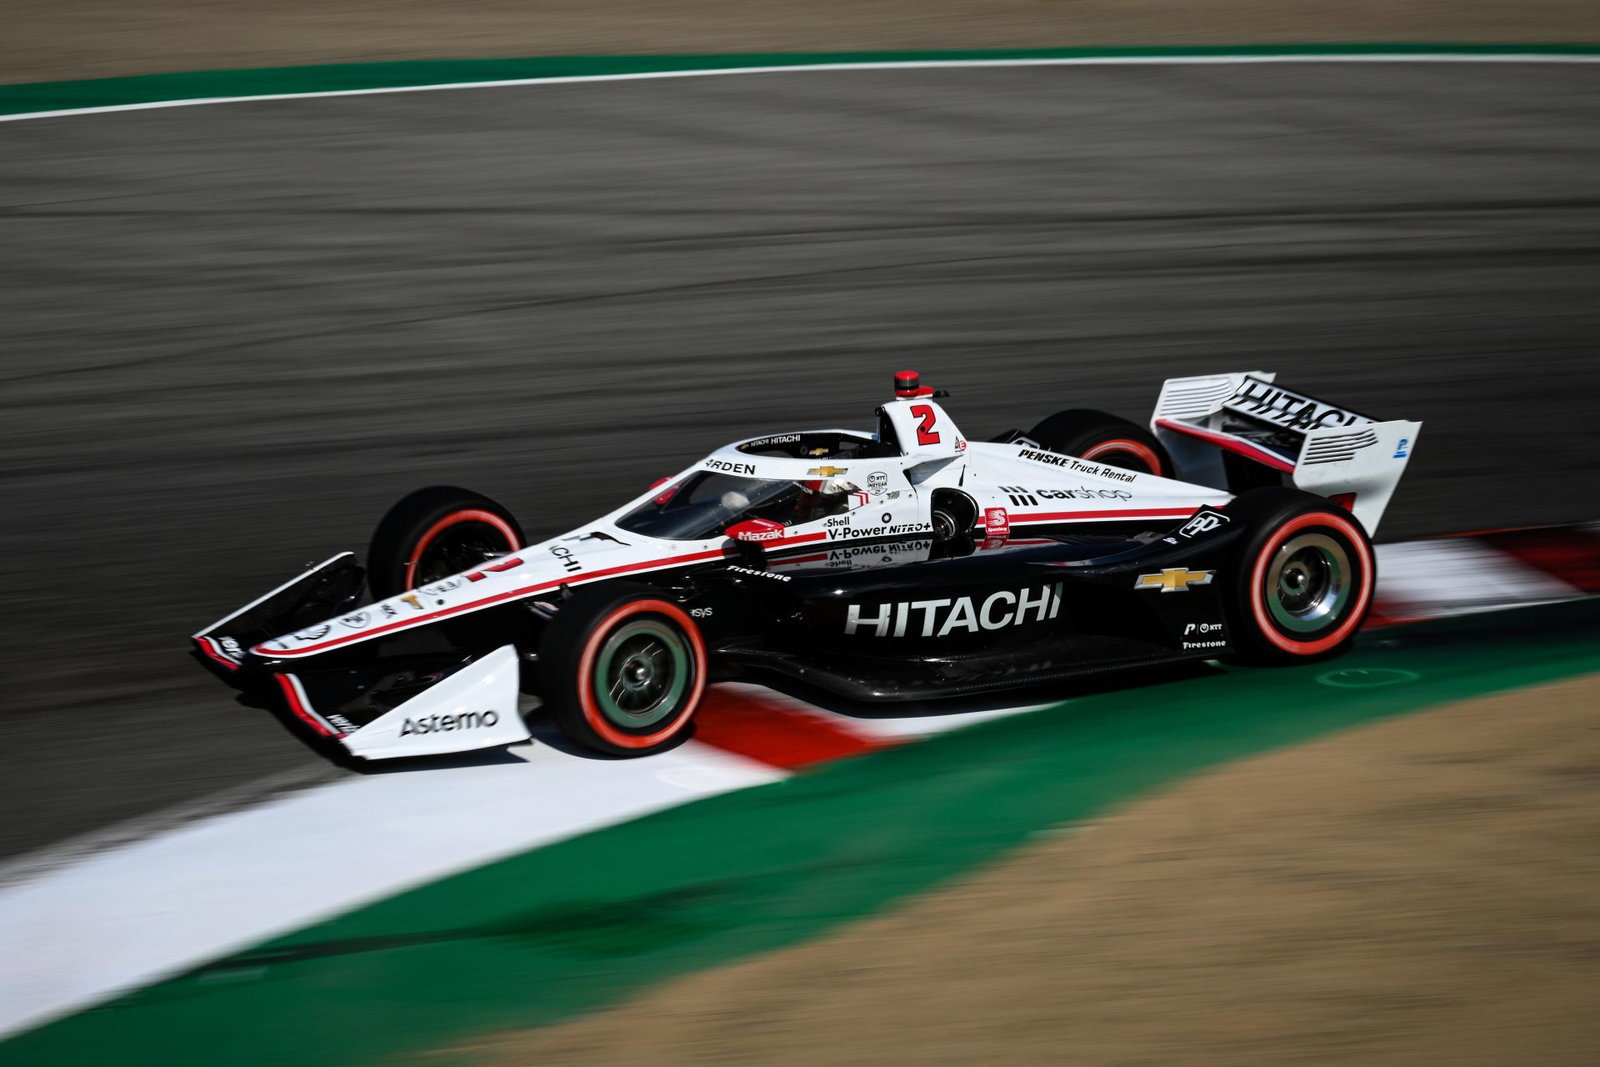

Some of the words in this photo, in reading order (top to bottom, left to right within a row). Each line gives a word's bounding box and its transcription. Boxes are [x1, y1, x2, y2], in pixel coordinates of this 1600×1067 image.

[910, 404, 941, 446] 2
[770, 434, 801, 445] HITACHI
[1018, 449, 1070, 467] PENSKE
[1070, 460, 1100, 475] Truck
[1100, 468, 1137, 483] Rental
[1036, 486, 1133, 502] carshop
[827, 516, 850, 528] Shell
[737, 529, 783, 541] Mazak
[828, 526, 887, 540] V-Power
[726, 565, 792, 582] Firestone
[844, 582, 1064, 638] HITACHI
[1182, 640, 1226, 650] Firestone
[398, 710, 499, 738] Astemo
